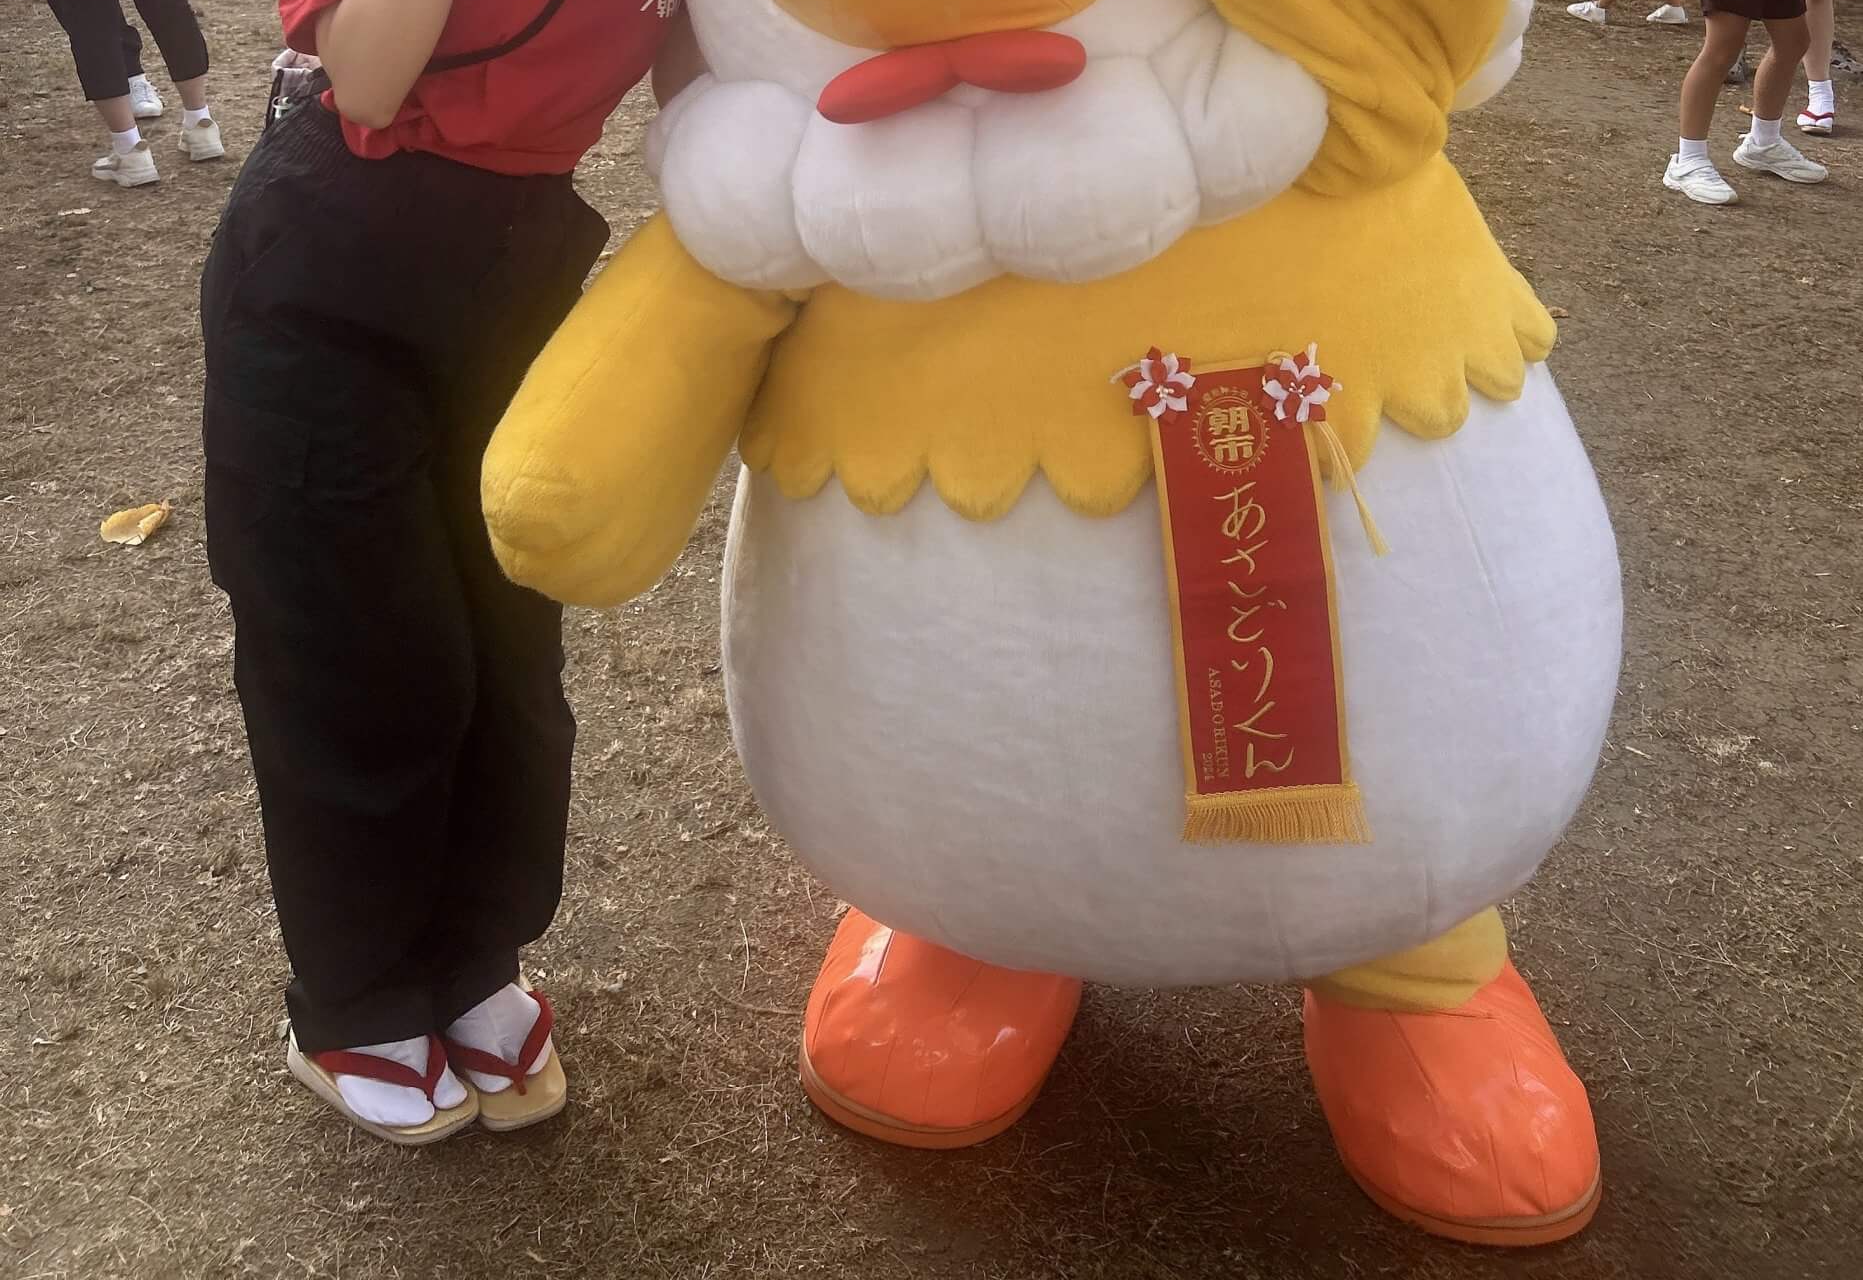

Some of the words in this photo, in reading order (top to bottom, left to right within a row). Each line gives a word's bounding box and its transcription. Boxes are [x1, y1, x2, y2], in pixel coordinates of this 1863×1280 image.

[1207, 406, 1256, 463] 朝市
[1212, 481, 1295, 779] あさどりくん
[1208, 667, 1230, 778] ASADORIKUN
